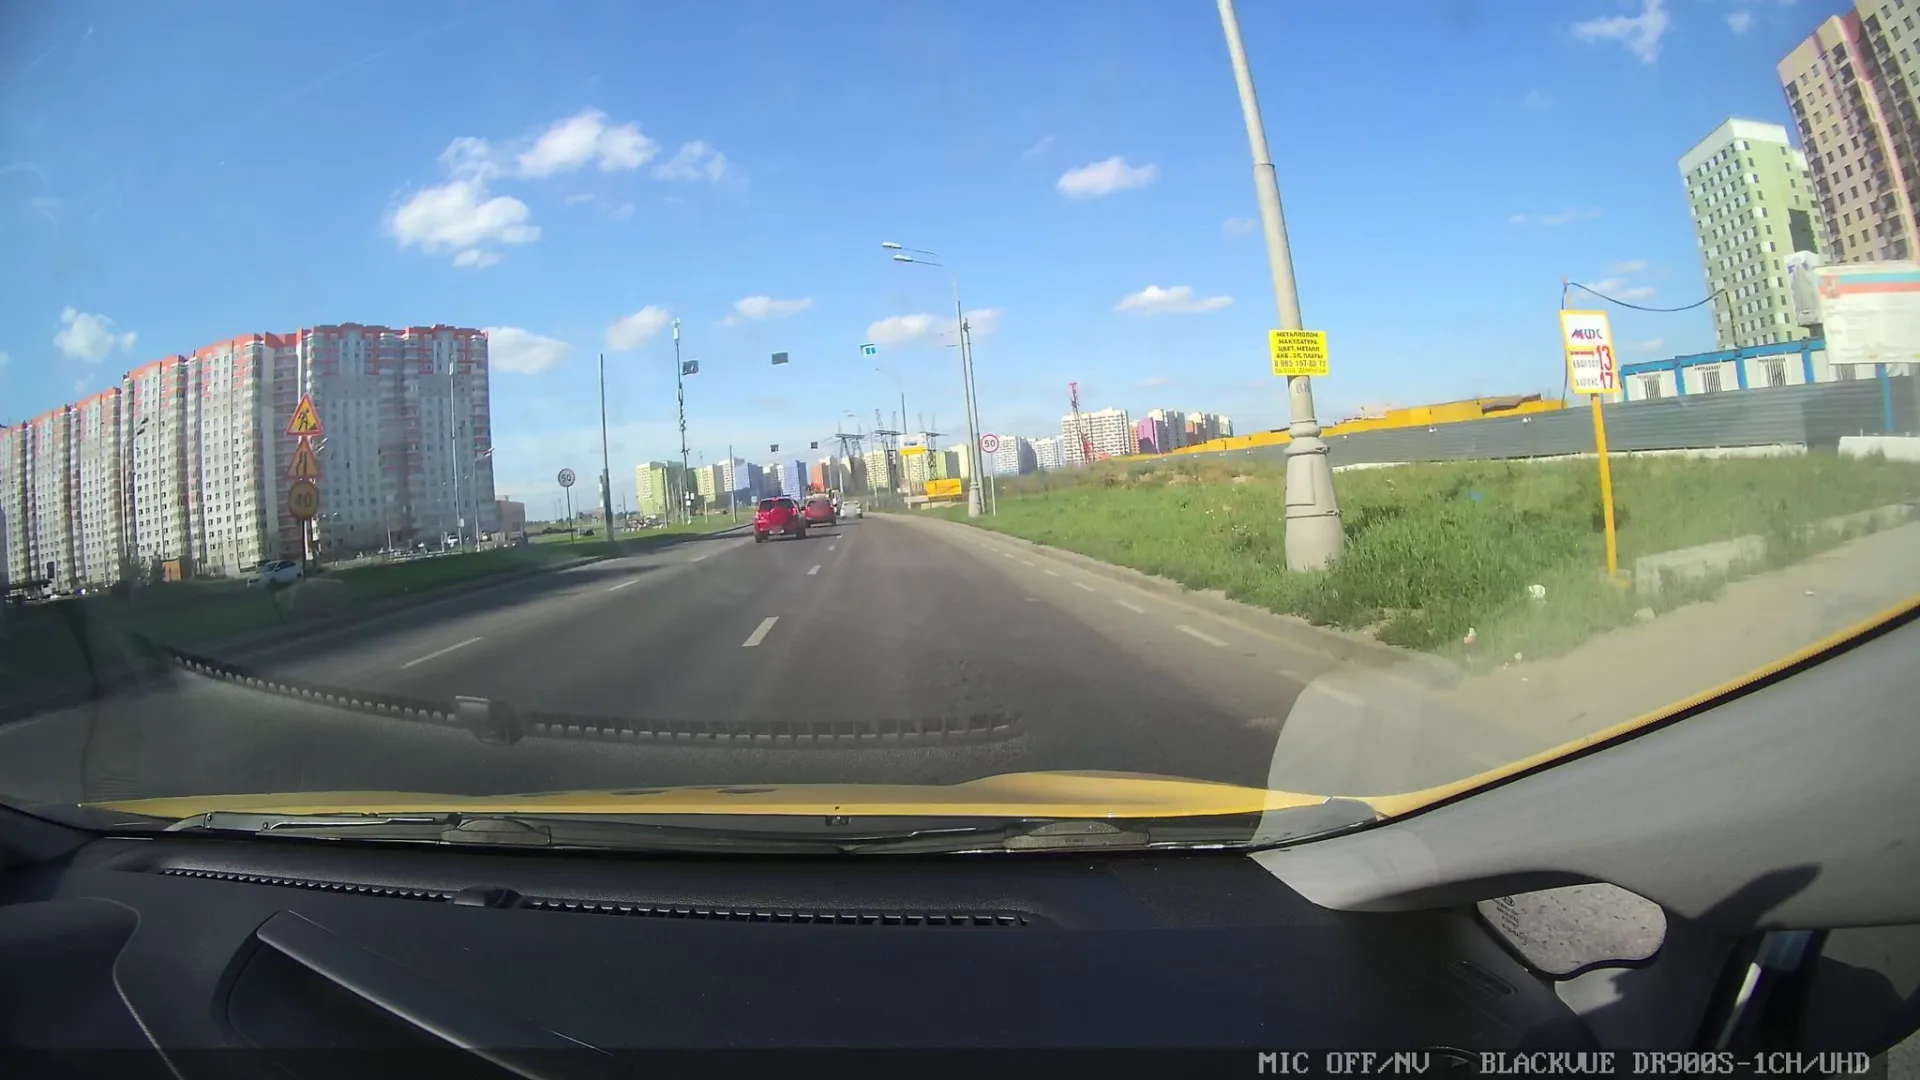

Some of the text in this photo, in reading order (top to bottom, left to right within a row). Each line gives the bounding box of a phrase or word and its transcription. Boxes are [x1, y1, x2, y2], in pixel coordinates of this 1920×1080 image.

[1597, 345, 1612, 370] 13
[1600, 371, 1613, 389] 17
[985, 439, 995, 448] 50
[561, 474, 572, 482] 50
[294, 492, 312, 508] 40
